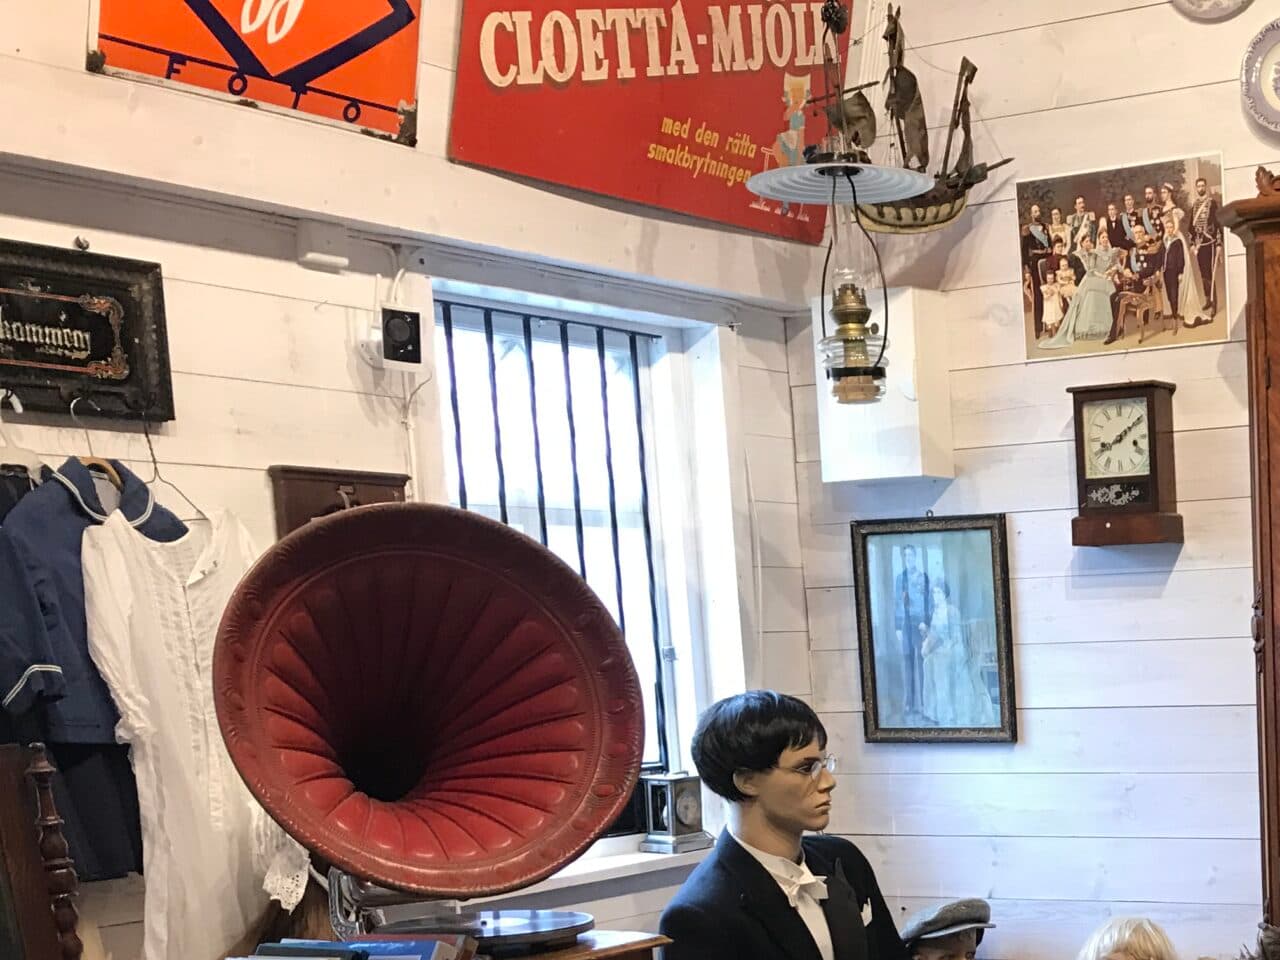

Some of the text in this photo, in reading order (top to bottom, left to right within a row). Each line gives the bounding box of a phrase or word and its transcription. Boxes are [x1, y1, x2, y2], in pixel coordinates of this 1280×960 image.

[661, 117, 757, 159] med den rätta
